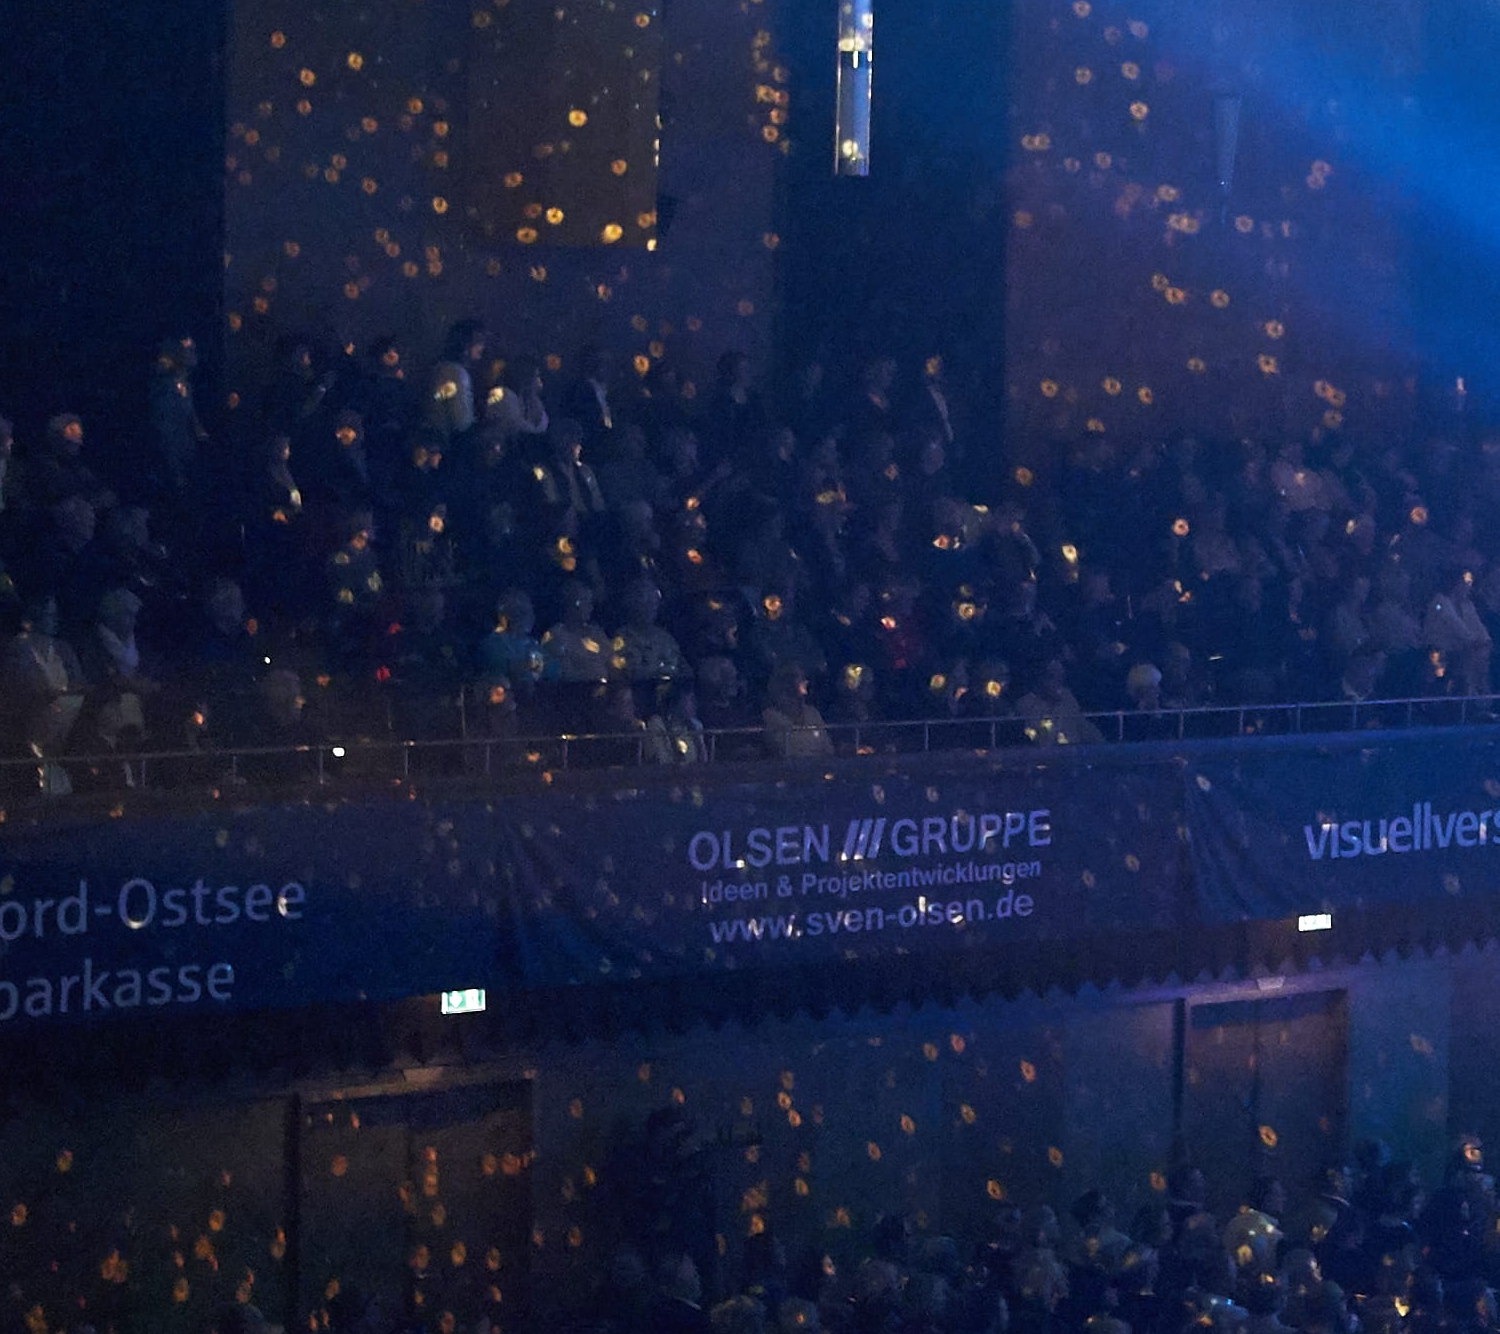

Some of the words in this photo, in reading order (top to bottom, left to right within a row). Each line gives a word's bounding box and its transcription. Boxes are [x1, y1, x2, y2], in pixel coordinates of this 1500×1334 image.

[687, 823, 831, 871] OLSEN
[890, 809, 1053, 857] GRUPPE
[702, 880, 768, 904] Ideen
[777, 875, 793, 898] &
[801, 858, 1042, 899] Projektentwicklungen
[709, 890, 1036, 943] www.sven-olsen.de
